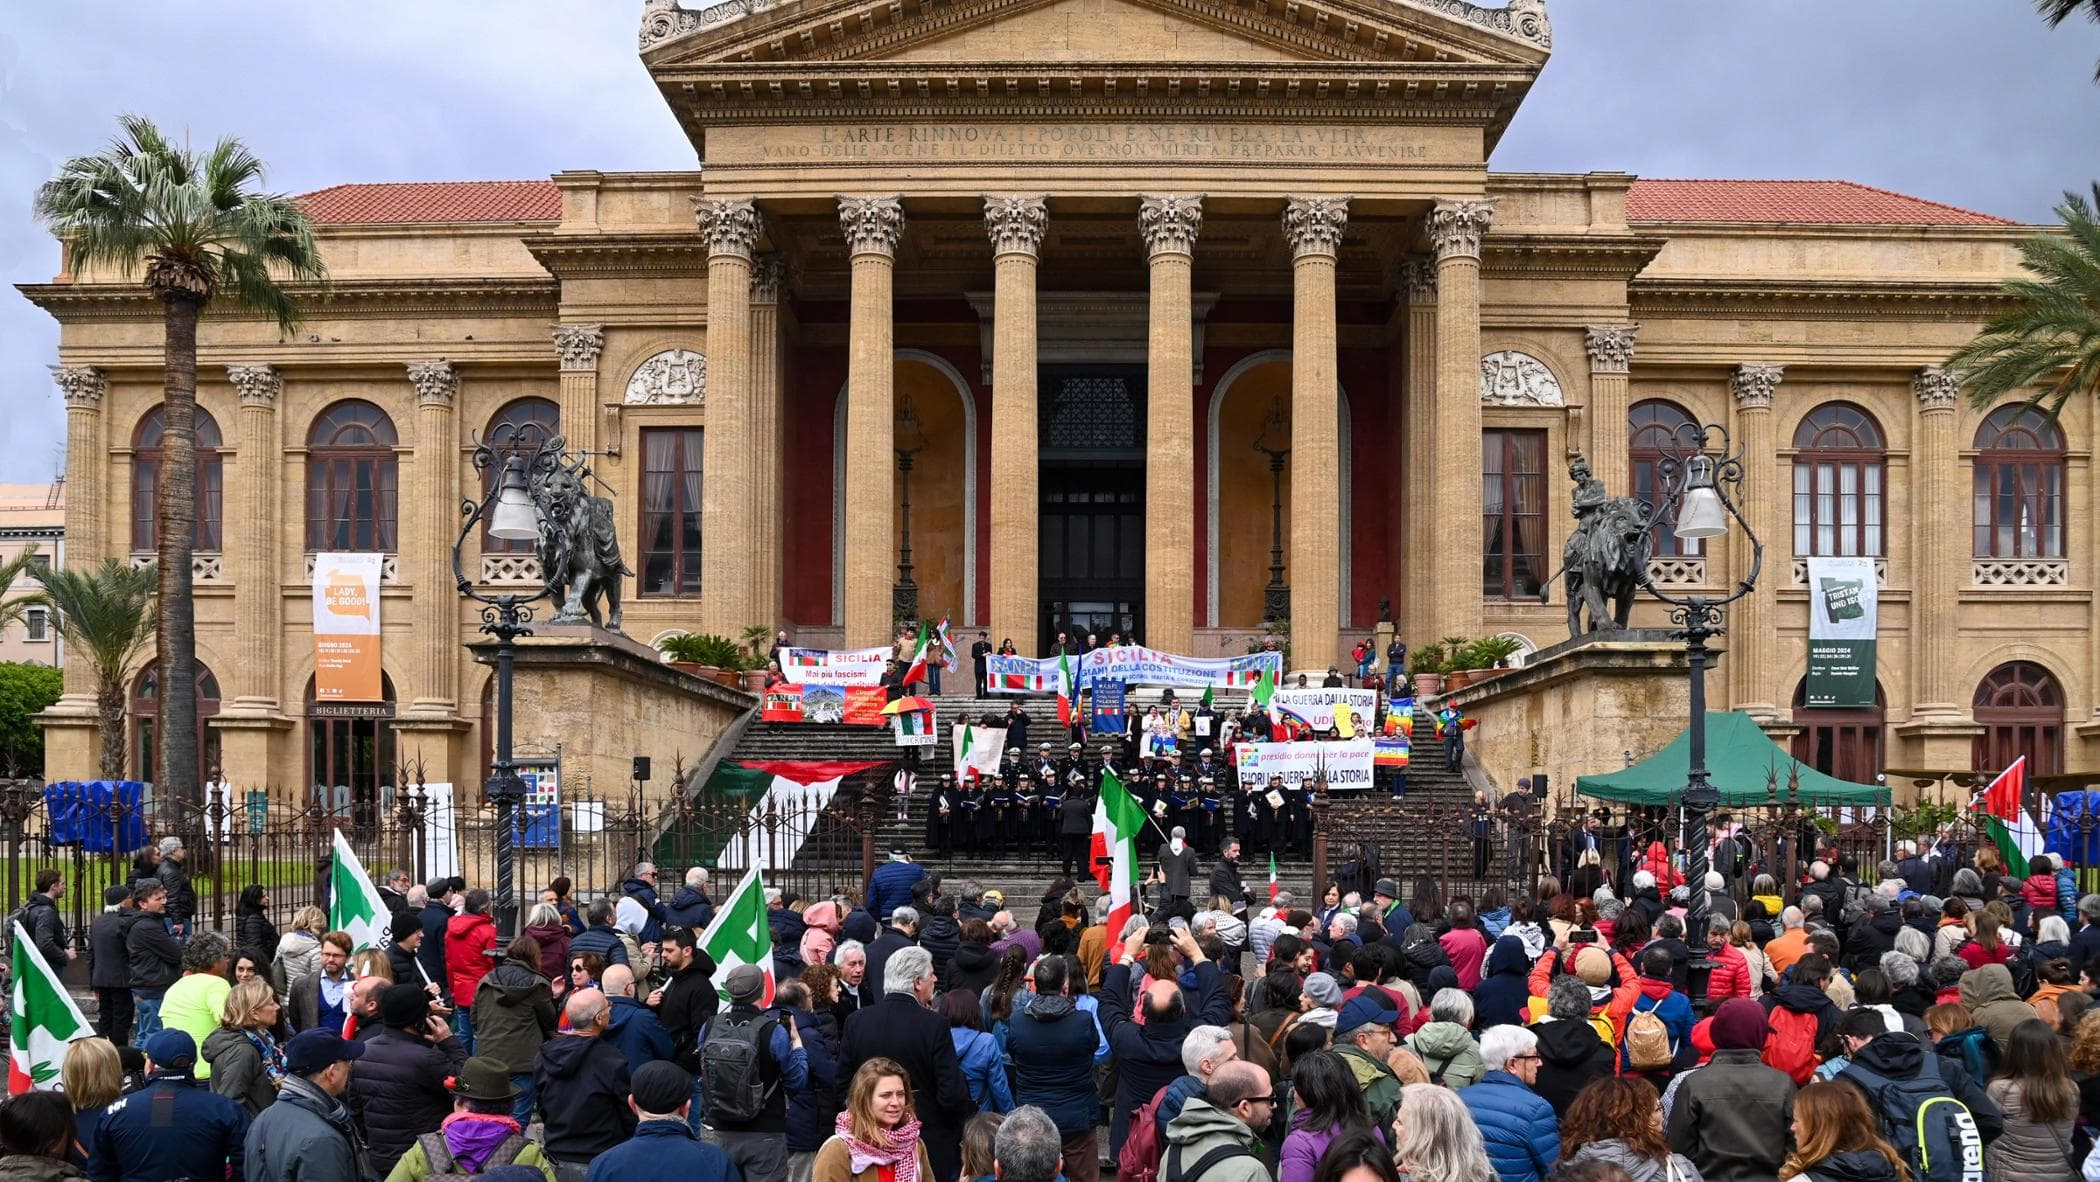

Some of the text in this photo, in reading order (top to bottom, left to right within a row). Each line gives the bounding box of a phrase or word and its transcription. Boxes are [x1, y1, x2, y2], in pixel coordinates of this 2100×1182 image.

[909, 127, 1007, 142] RINNOVA
[1039, 127, 1112, 142] POPOLI
[1125, 127, 1136, 142] E
[1149, 127, 1176, 142] NE
[1190, 127, 1267, 142] RIVELA
[1281, 127, 1304, 142] LA
[1315, 127, 1366, 143] VITA
[762, 144, 810, 157] VANO
[821, 144, 868, 157] DELLE
[881, 143, 940, 156] SCENE
[952, 143, 967, 156] IL
[979, 143, 1049, 156] DILETTO
[1063, 143, 1096, 155] OVE
[1109, 143, 1145, 156] NON
[1162, 143, 1199, 156] MIRI
[1211, 144, 1220, 156] A
[1230, 144, 1319, 157] PREPARAR
[1828, 586, 1859, 601] TRISTAN
[327, 597, 337, 605] BE
[1830, 599, 1846, 610] UND
[835, 654, 881, 663] SICILIA
[1094, 647, 1173, 665] SICILIA
[805, 670, 819, 678] Mai
[835, 670, 867, 678] fascismi
[1111, 663, 1140, 673] DELLA
[1142, 663, 1217, 678] COSTITUZIONE
[1282, 694, 1291, 704] LA
[1292, 693, 1323, 706] GUERRA
[1349, 694, 1374, 707] STORIA
[316, 706, 387, 715] BIGLIETTERIA
[1260, 750, 1293, 761] presidio
[1339, 750, 1349, 759] la
[1350, 750, 1369, 760] pace
[1341, 768, 1370, 783] STORIA
